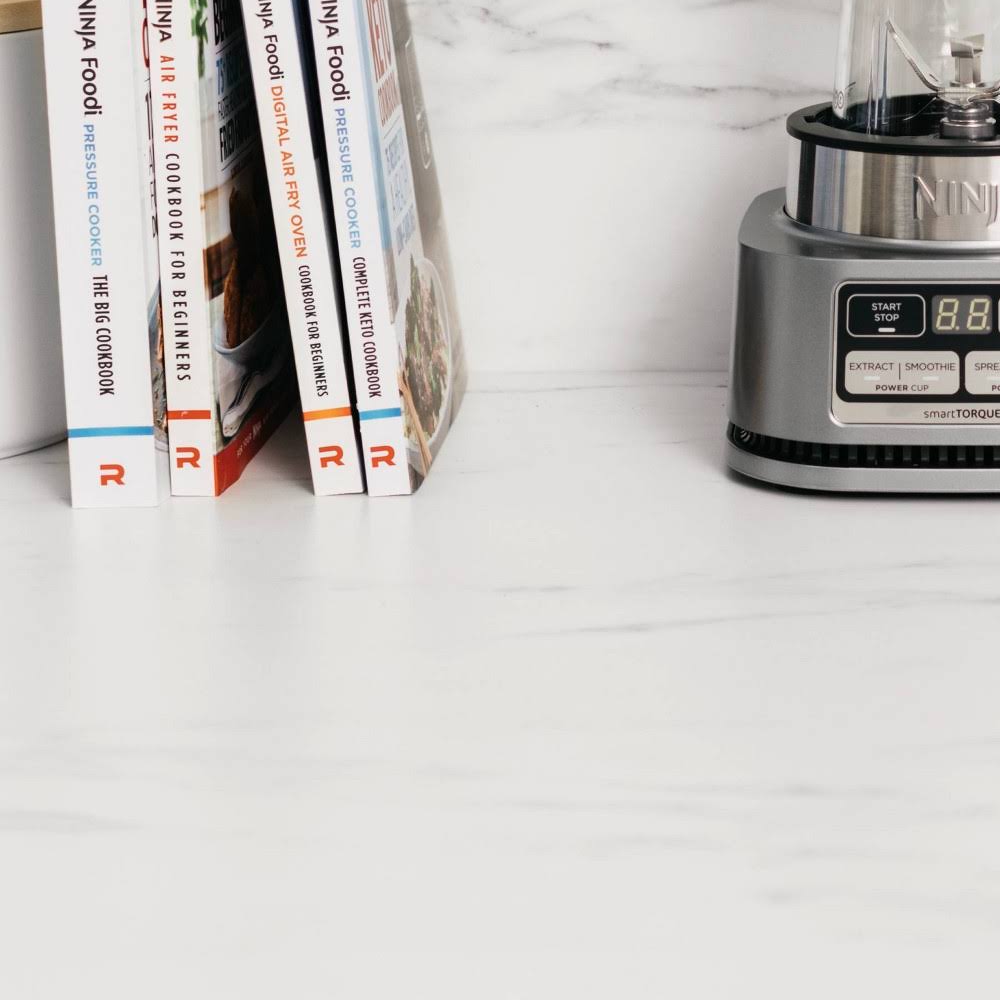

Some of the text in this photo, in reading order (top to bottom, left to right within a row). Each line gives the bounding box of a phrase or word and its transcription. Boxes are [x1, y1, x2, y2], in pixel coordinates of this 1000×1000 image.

[160, 56, 175, 82] AIR
[264, 35, 284, 80] Foodi
[327, 45, 350, 101] Foodi
[81, 58, 102, 116] Foodi
[162, 93, 178, 142] FRYER
[271, 86, 290, 146] DIGITAL
[84, 125, 98, 199] PRESSURE
[281, 151, 295, 176] AIR
[334, 108, 354, 184] PRESSURE
[166, 153, 184, 240] COOKBOOK
[285, 181, 300, 209] FRY
[89, 205, 102, 265] COOKER
[291, 215, 307, 257] OVEN
[345, 188, 360, 248] COOKER
[93, 275, 109, 297] THE
[170, 251, 185, 279] FOR
[353, 257, 371, 310] COMPLETE
[94, 302, 110, 323] BIG
[298, 265, 317, 318] COOKBOOK
[872, 302, 902, 311] START
[173, 290, 191, 380] BEGINNERS
[307, 321, 320, 340] FOR
[359, 312, 374, 337] KETO
[874, 313, 900, 322] STOP
[96, 328, 115, 396] COOKBOOK
[310, 343, 328, 397] BEGINNERS
[363, 342, 382, 398] COOKBOOK
[849, 362, 894, 371] EXTRACT
[905, 362, 956, 371] SMOOTHIE
[875, 384, 929, 392] POWER CUP
[923, 408, 1000, 419] smartTORQUE
